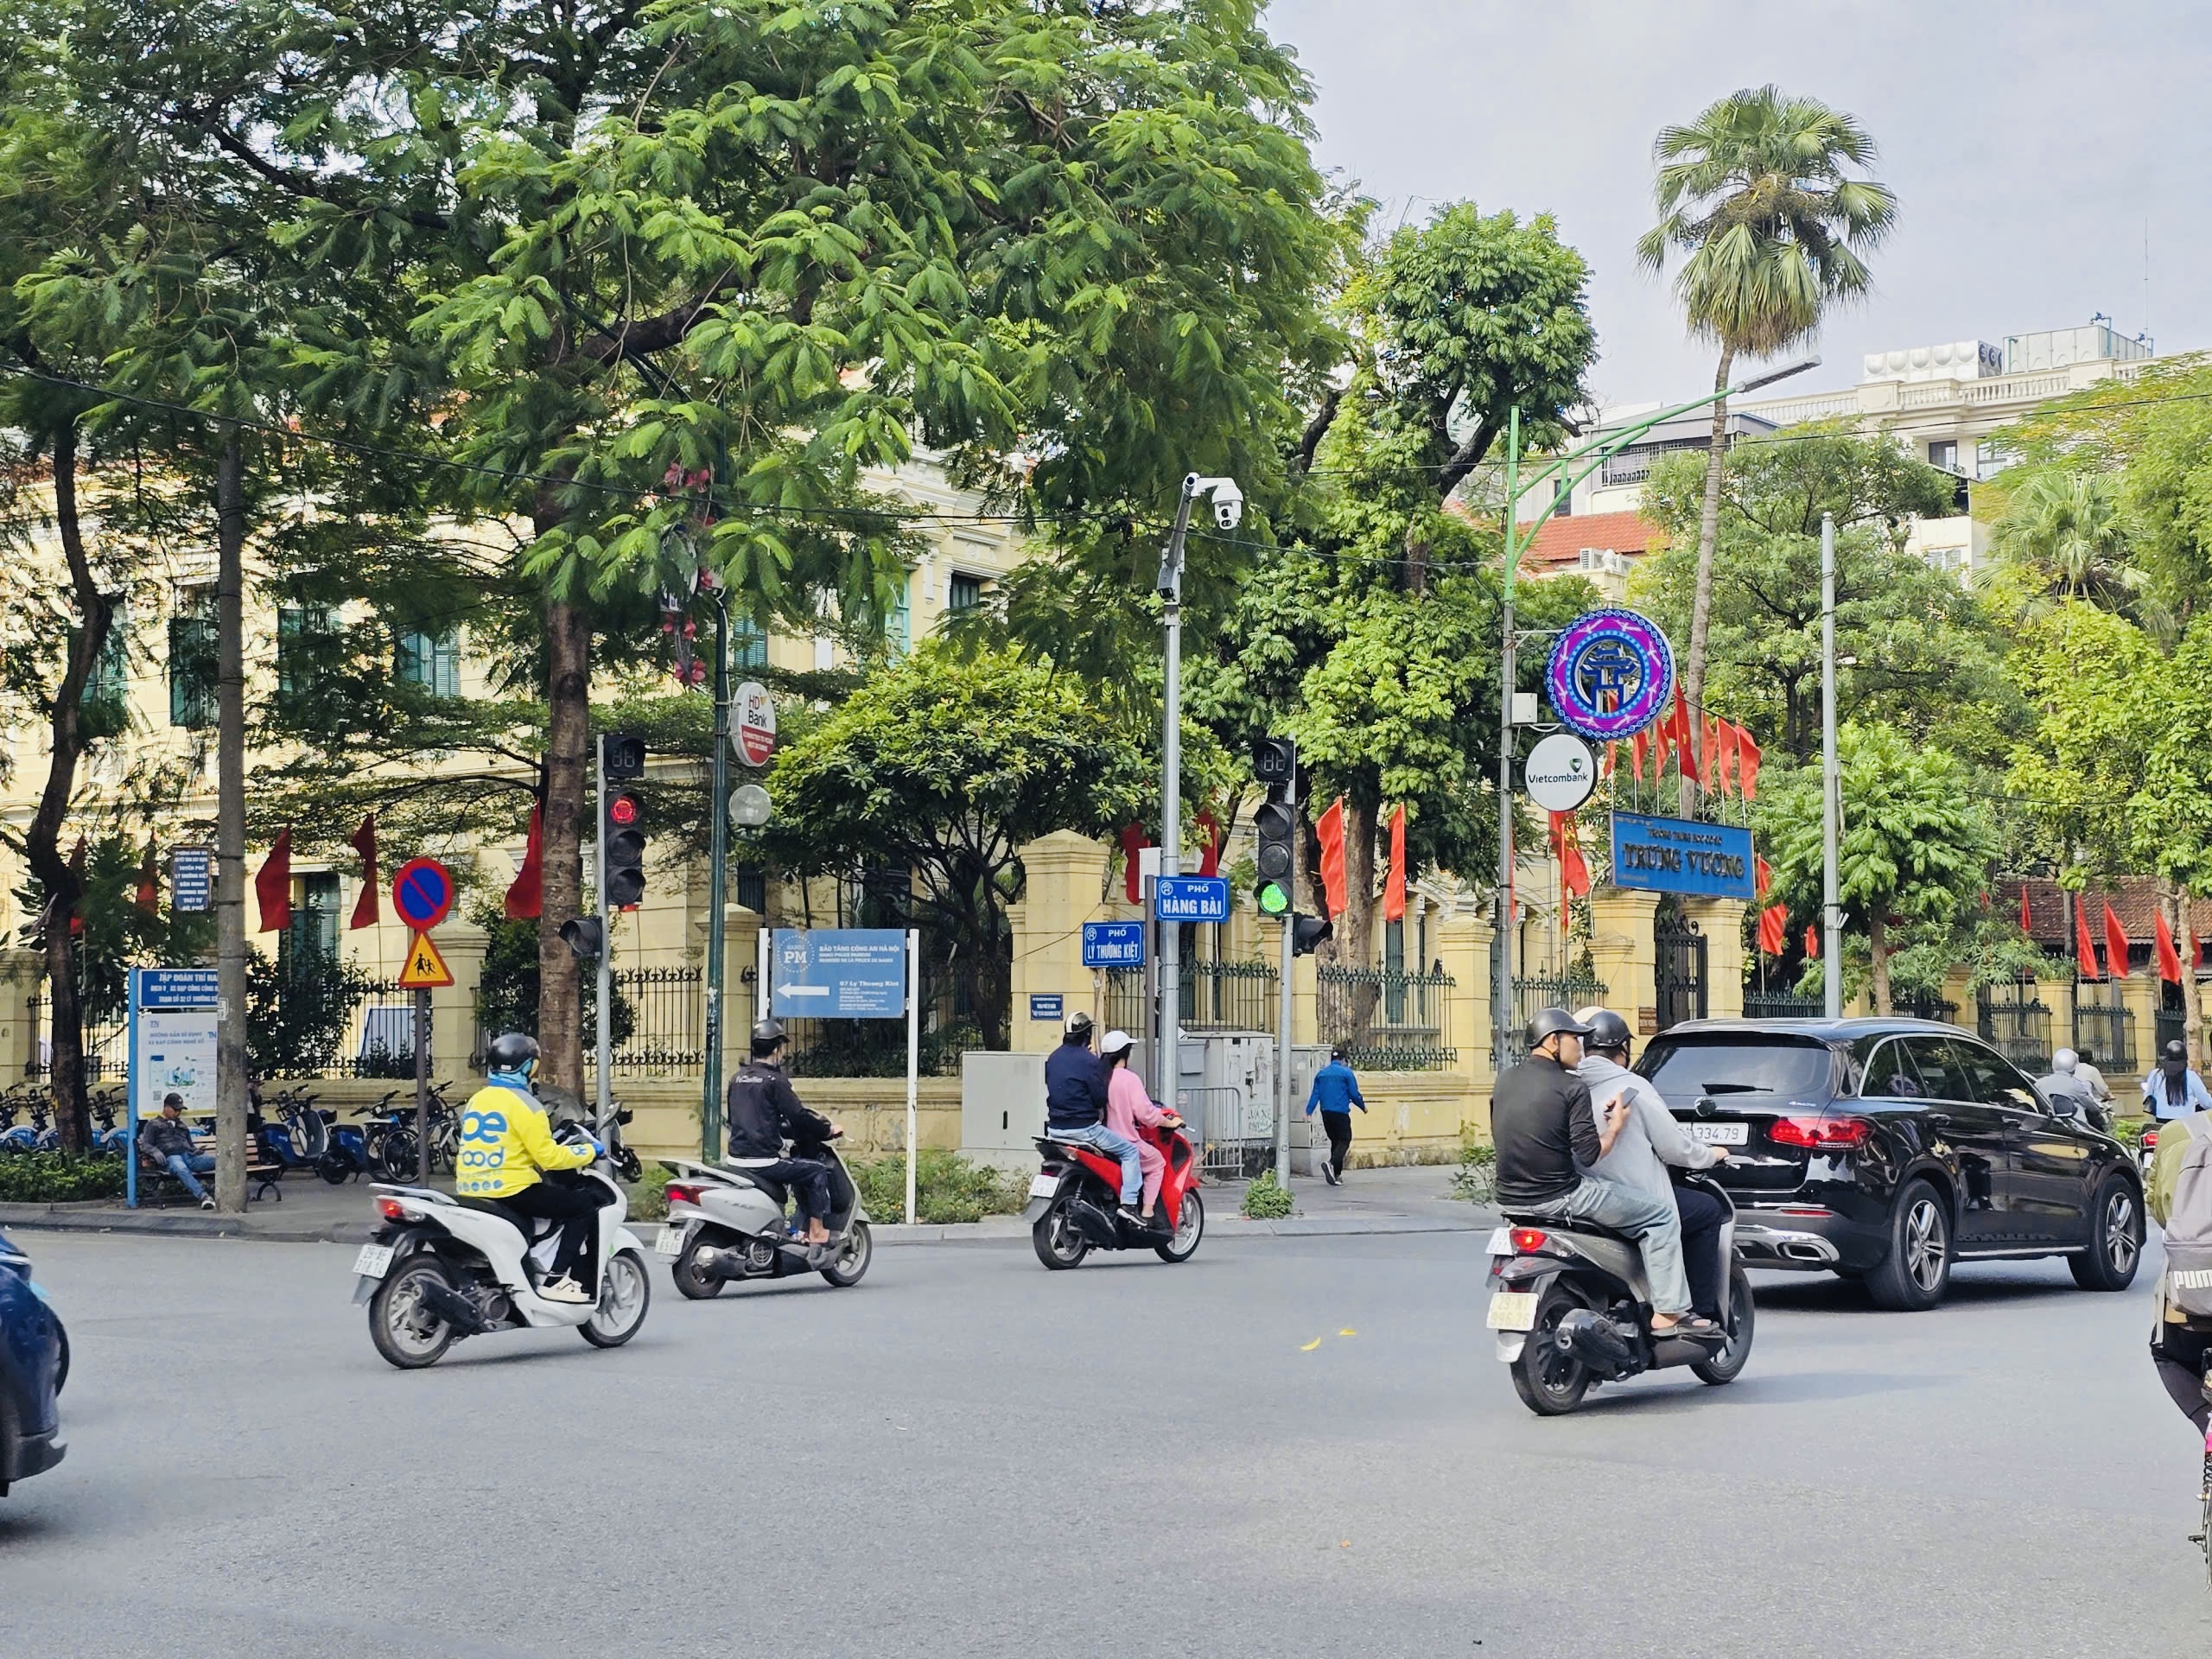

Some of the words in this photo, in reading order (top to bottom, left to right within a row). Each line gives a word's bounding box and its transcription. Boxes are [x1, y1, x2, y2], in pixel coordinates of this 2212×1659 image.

[749, 694, 760, 709] HD
[748, 709, 767, 728] Bank
[1529, 772, 1588, 784] Vietcombank
[1187, 882, 1209, 893] PHỐ
[1162, 896, 1198, 914] HÀNG
[1200, 896, 1222, 915] BÀI
[1108, 927, 1127, 938] PHỐ
[784, 951, 808, 963] PM
[1087, 941, 1096, 959] LÝ
[1096, 940, 1122, 959] THƯỜNG
[1123, 940, 1139, 961] KIỆT
